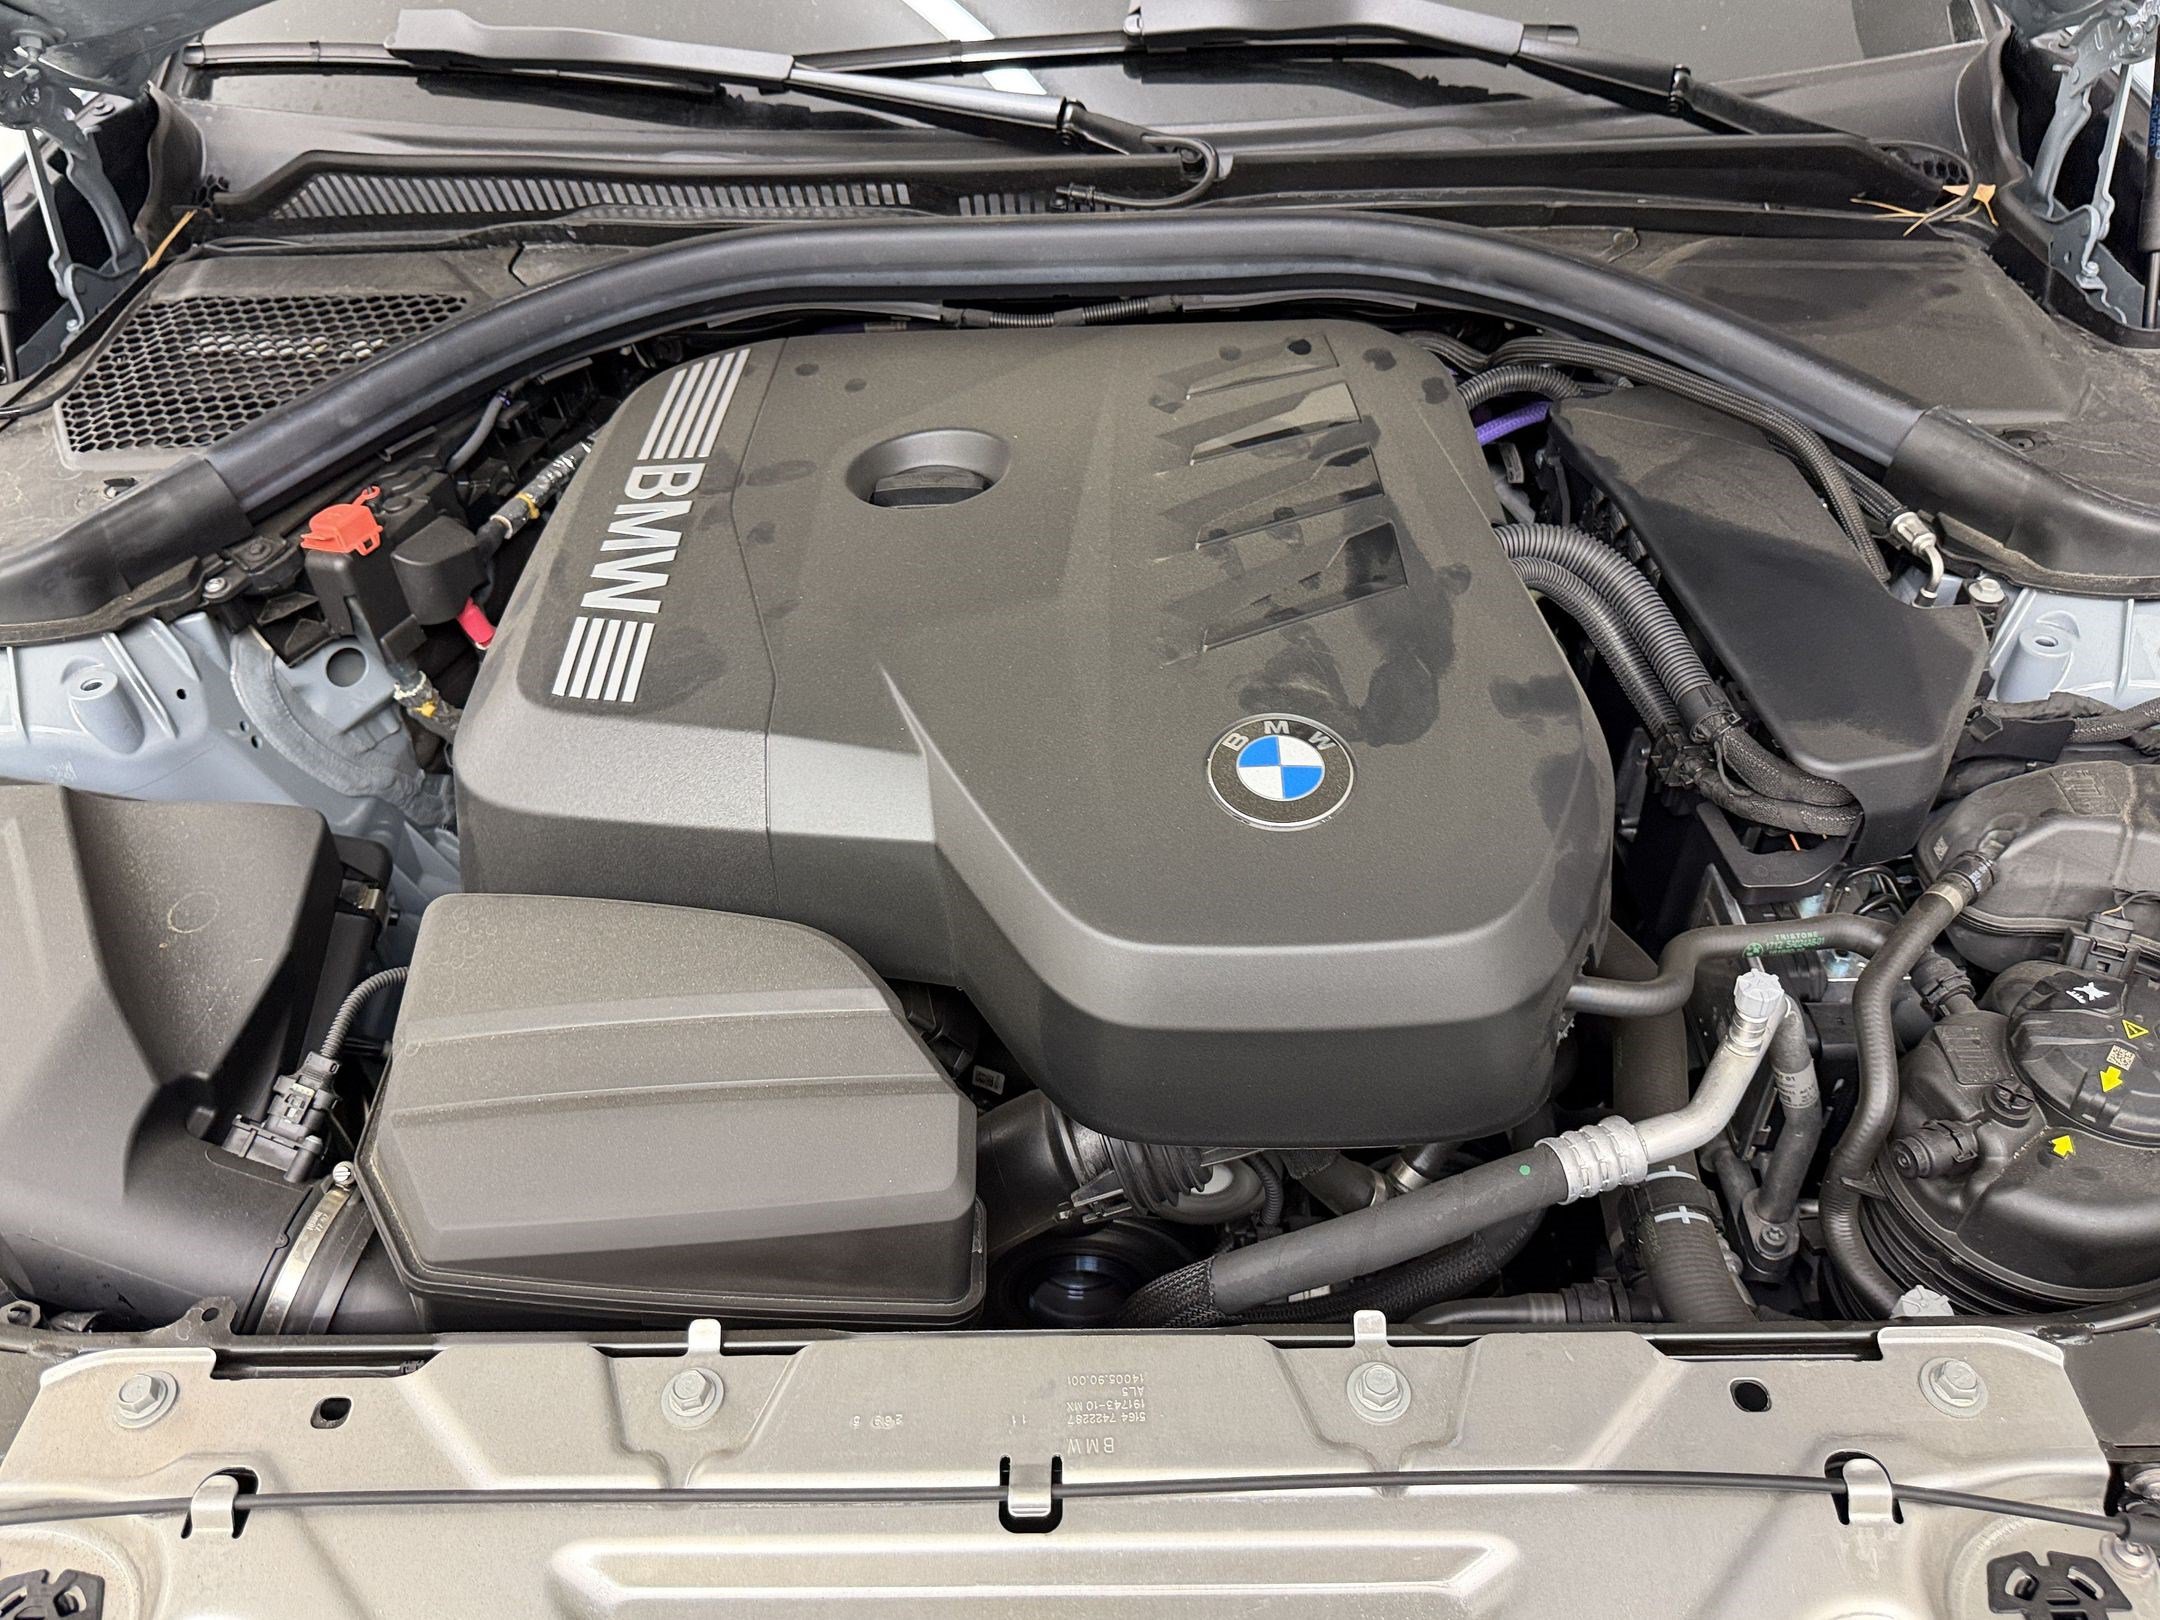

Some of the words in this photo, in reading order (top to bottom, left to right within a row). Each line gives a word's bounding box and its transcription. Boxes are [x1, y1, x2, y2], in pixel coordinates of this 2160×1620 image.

[580, 463, 706, 614] BMW
[1222, 720, 1338, 752] BMW
[1067, 1373, 1145, 1386] 14005.90.001
[1121, 1386, 1145, 1397] AL5
[1086, 1398, 1146, 1411] 191743-10
[1120, 1411, 1146, 1422] 5164
[1066, 1436, 1115, 1455] BMW
